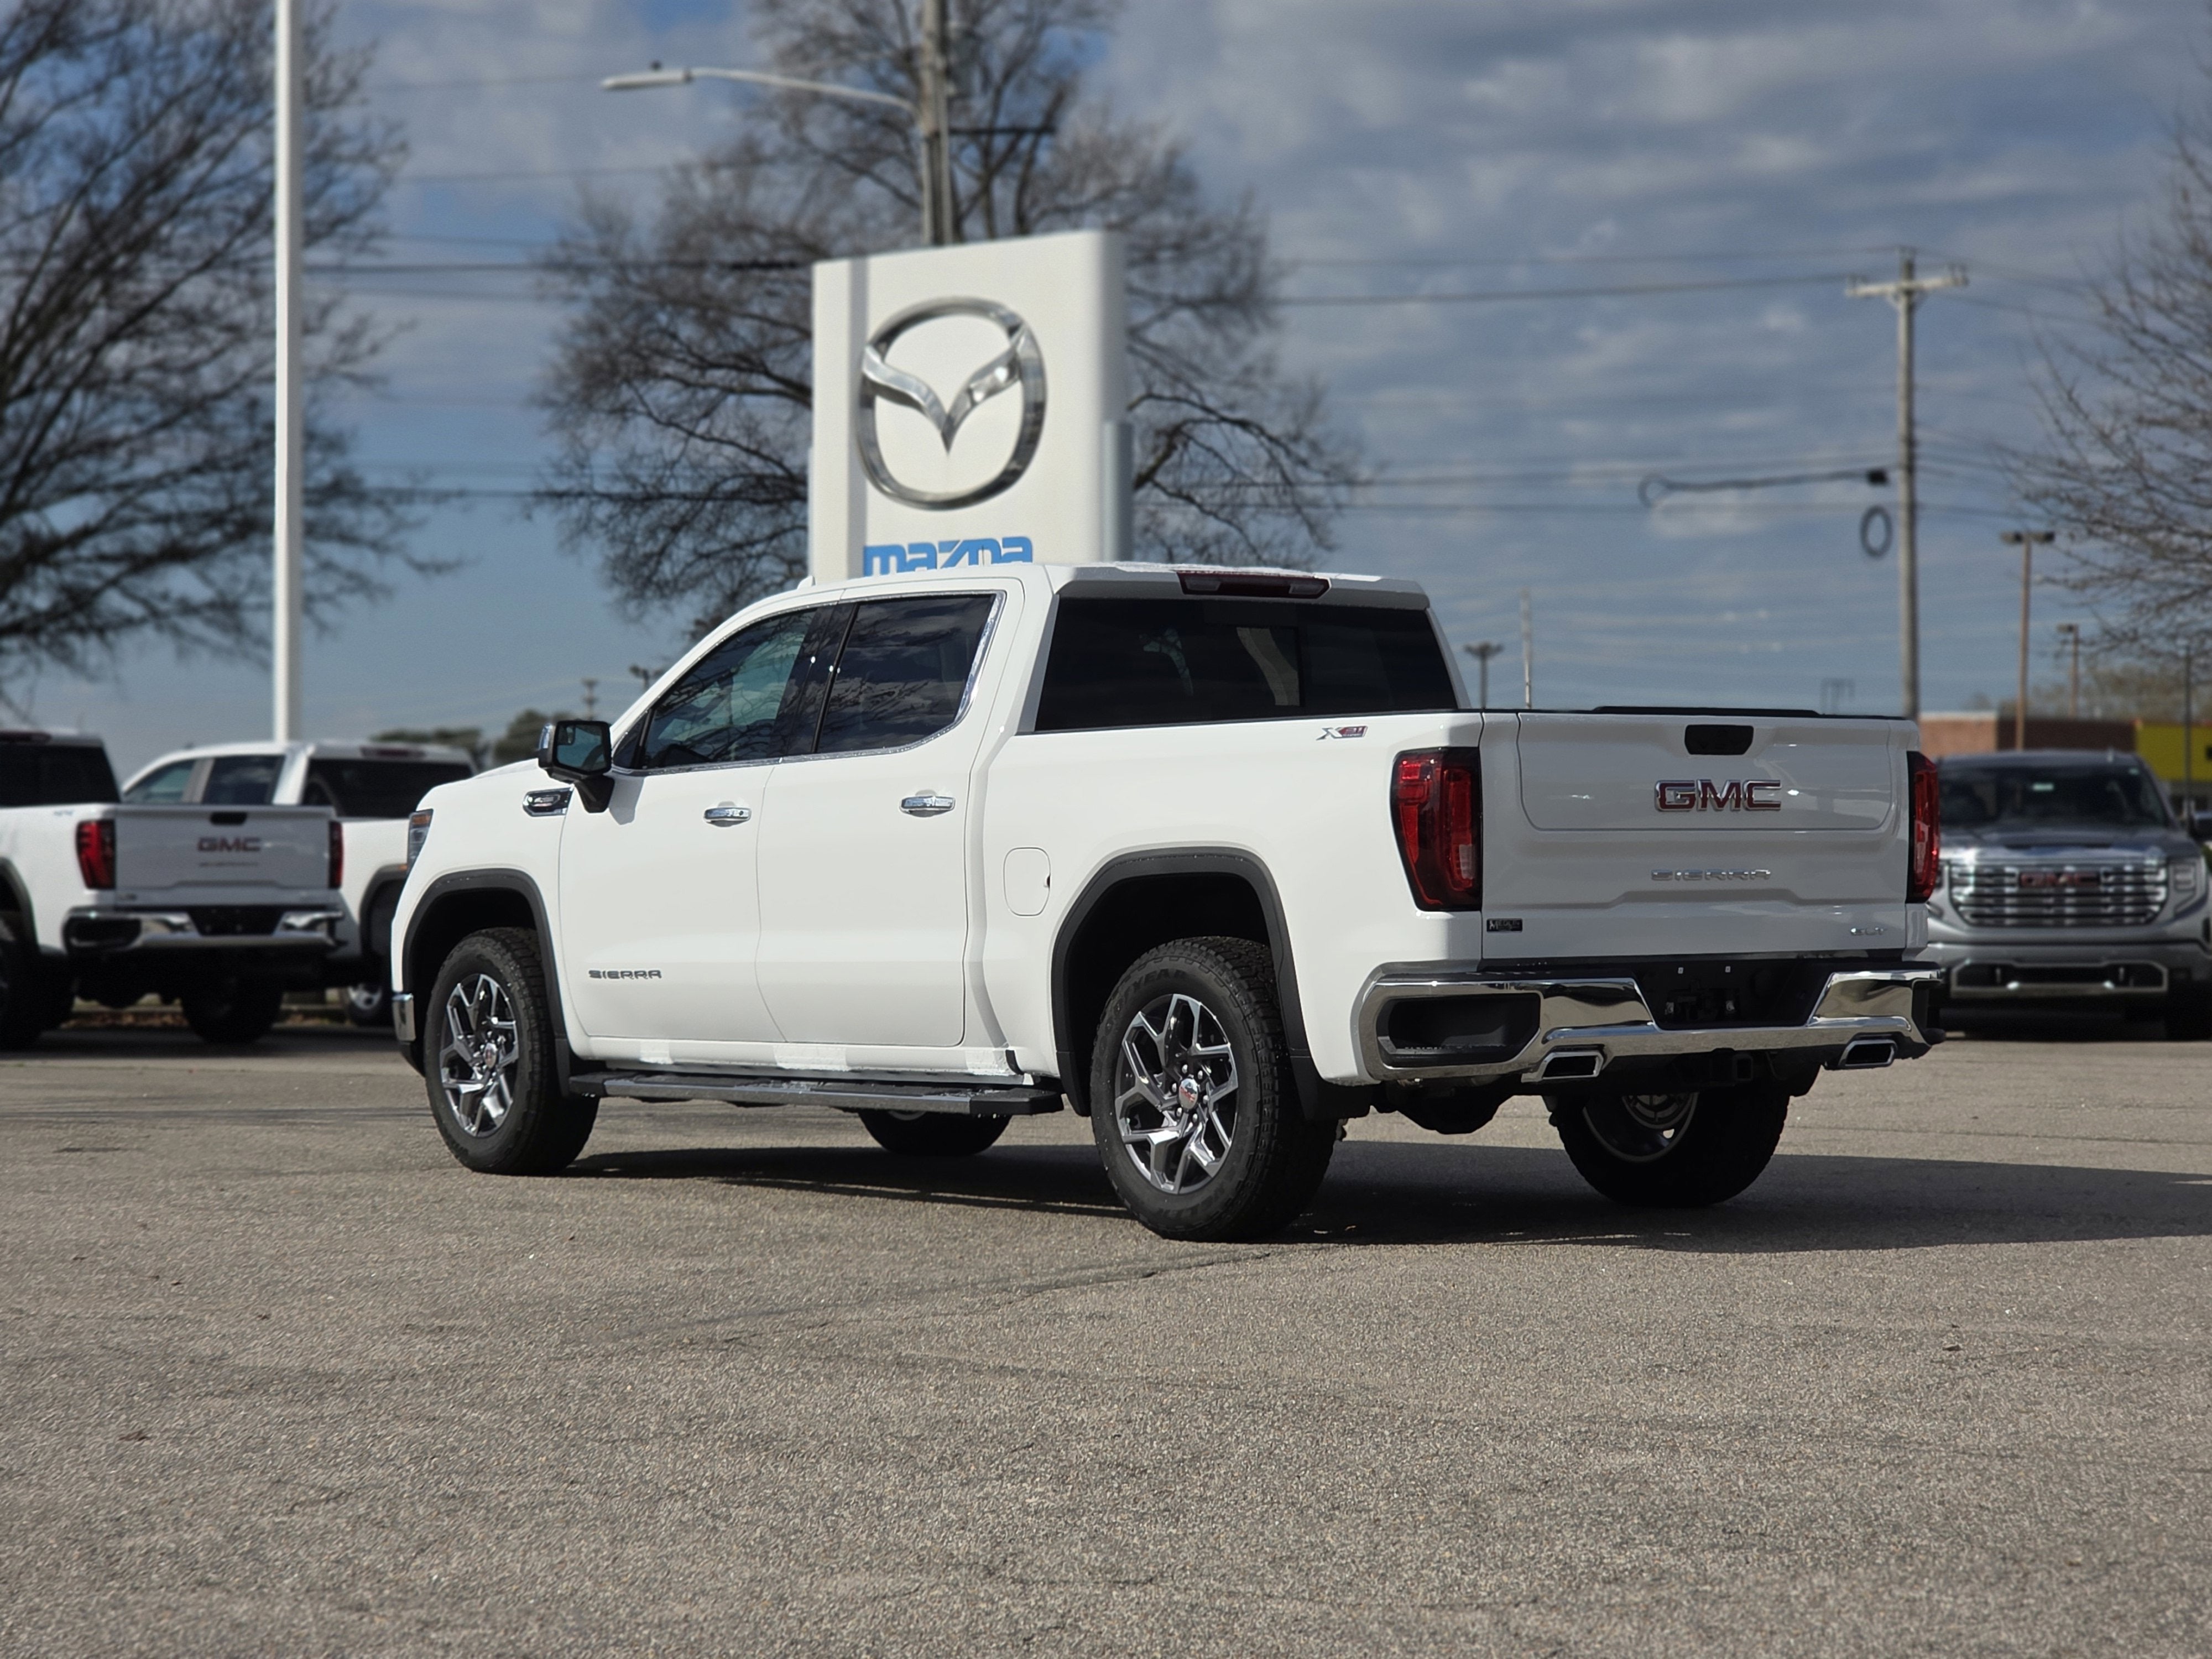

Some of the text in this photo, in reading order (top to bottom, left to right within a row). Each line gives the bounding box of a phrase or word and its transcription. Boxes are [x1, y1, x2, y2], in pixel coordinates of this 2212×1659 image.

[864, 536, 1033, 577] mazda
[1654, 779, 1782, 811] GMC
[197, 836, 262, 852] GMC
[1651, 869, 1771, 881] SIERRA
[588, 969, 662, 979] SIERRA
